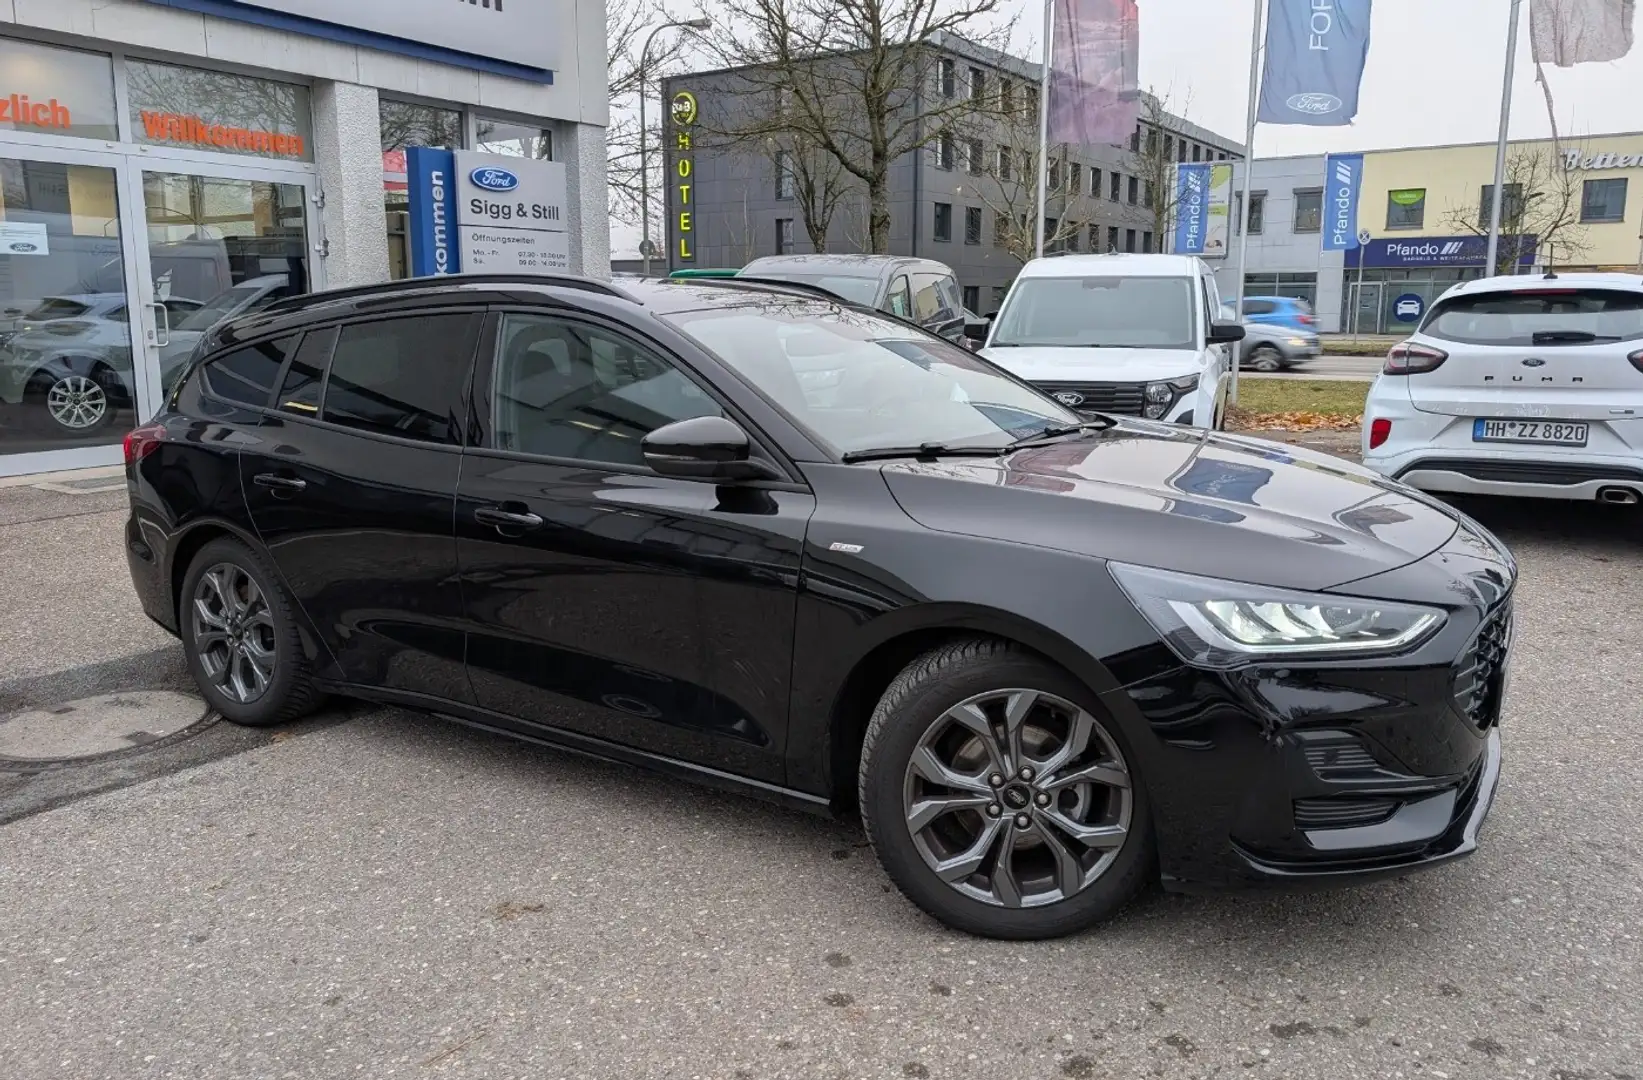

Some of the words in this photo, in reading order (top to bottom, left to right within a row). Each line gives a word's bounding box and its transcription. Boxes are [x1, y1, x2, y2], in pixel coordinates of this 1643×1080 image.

[140, 110, 305, 156] Willkommen
[678, 131, 693, 258] HOTEL
[470, 198, 513, 220] Sigg
[516, 203, 528, 218] &
[532, 203, 560, 221] Still
[1332, 187, 1351, 245] Pfando
[1186, 194, 1201, 249] Pfando
[471, 233, 536, 245] Öffnungszeiten
[1386, 243, 1439, 256] Pfando
[1484, 375, 1583, 383] PUMA
[1485, 421, 1507, 437] HH
[1517, 423, 1539, 438] ZZ
[1542, 423, 1585, 441] 8820
